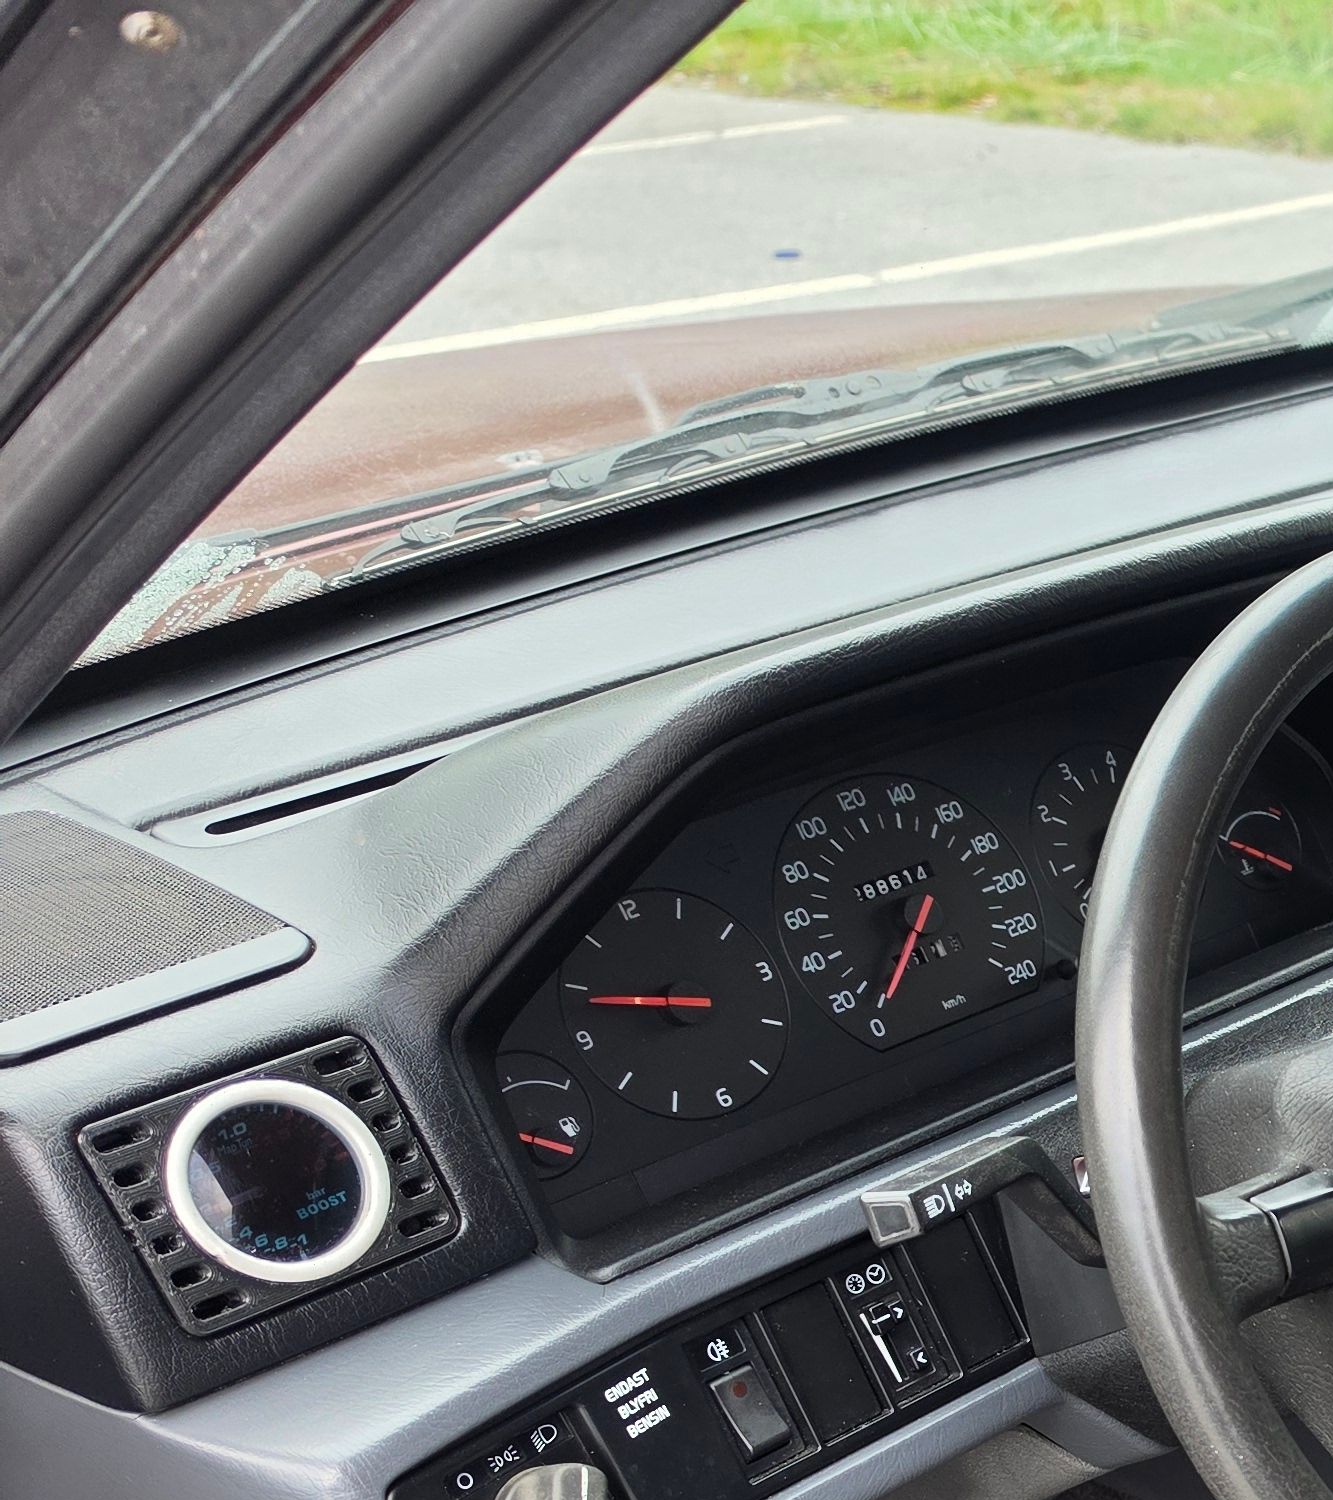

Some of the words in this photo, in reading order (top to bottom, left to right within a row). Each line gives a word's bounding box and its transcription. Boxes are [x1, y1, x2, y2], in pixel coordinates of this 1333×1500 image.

[1106, 751, 1116, 766] 4
[1058, 762, 1073, 781] 3
[836, 788, 866, 812] 120
[886, 782, 916, 806] 140
[934, 800, 964, 824] 160
[1036, 804, 1052, 822] 2
[795, 816, 828, 840] 100
[970, 832, 1000, 855] 180
[782, 860, 810, 884] 80
[992, 868, 1027, 894] 200
[618, 900, 641, 921] 12
[784, 908, 811, 931] 60
[1004, 912, 1038, 938] 220
[756, 962, 774, 982] 3
[801, 951, 826, 973] 40
[1004, 959, 1038, 985] 240
[828, 990, 856, 1014] 20
[941, 994, 966, 1012] km/h
[870, 1018, 886, 1037] 0
[574, 1030, 594, 1050] 9
[716, 1087, 734, 1108] 6
[218, 1121, 248, 1141] 1.0
[296, 1190, 348, 1220] BOOST
[305, 1187, 326, 1201] bar
[604, 1367, 650, 1402] ENDAST
[617, 1388, 659, 1420] BLYFRI
[626, 1404, 671, 1439] BENSIN
